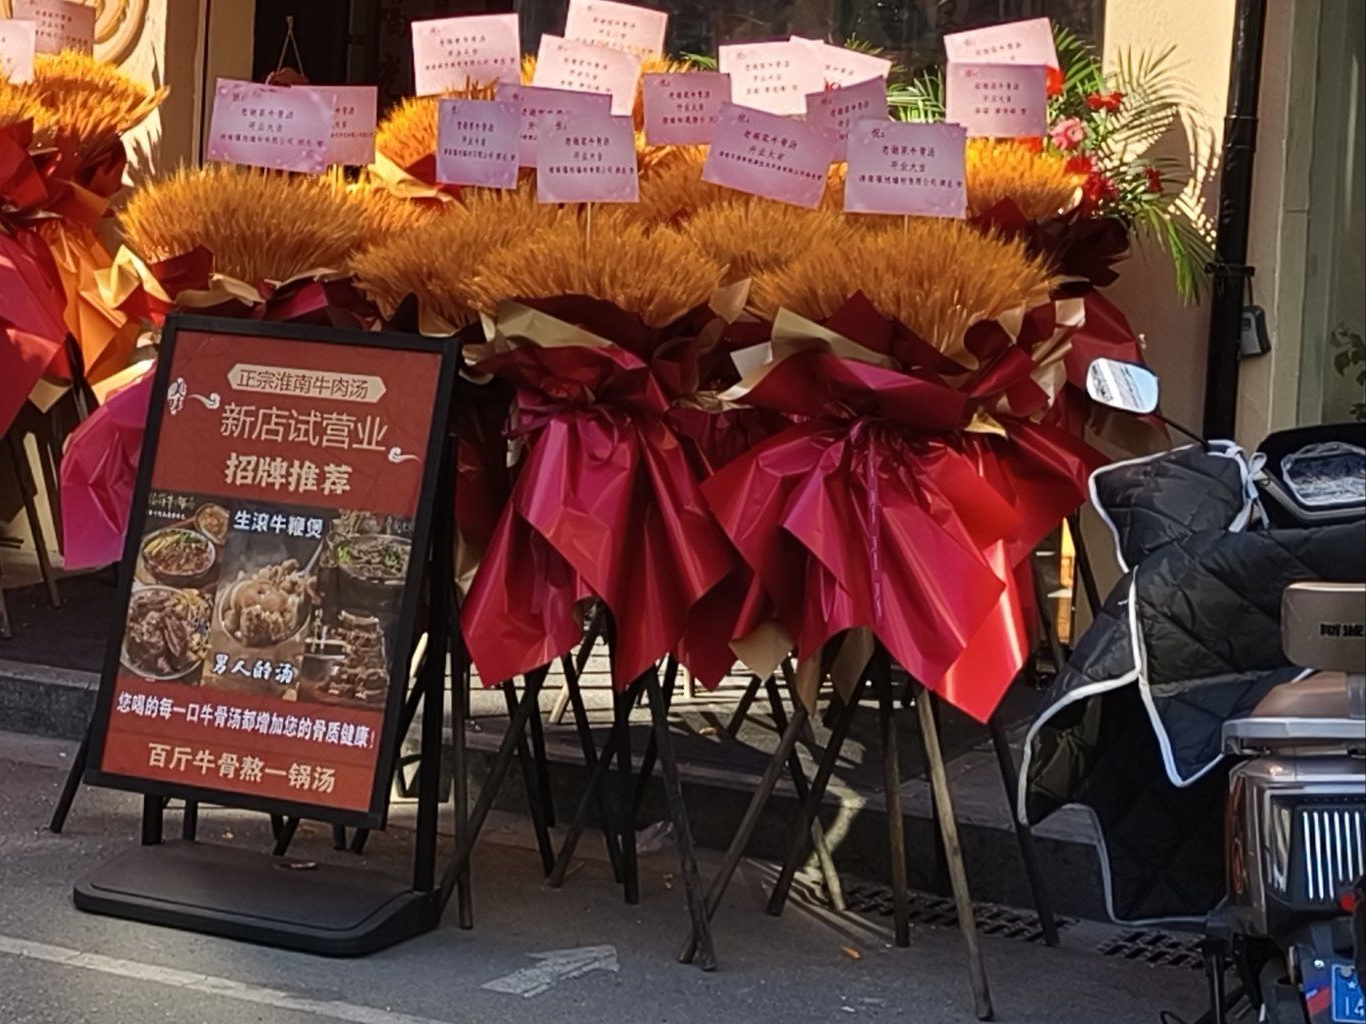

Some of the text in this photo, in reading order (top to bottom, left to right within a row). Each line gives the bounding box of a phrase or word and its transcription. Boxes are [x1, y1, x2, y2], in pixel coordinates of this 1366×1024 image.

[236, 369, 369, 399] 正宗淮南牛肉汤
[220, 402, 388, 451] 新店试营业
[224, 452, 353, 495] 招牌推荐
[234, 510, 324, 538] 生滚牛鞭煲
[212, 654, 295, 684] 男人的汤
[148, 742, 336, 793] 百斤牛骨熬一锅汤
